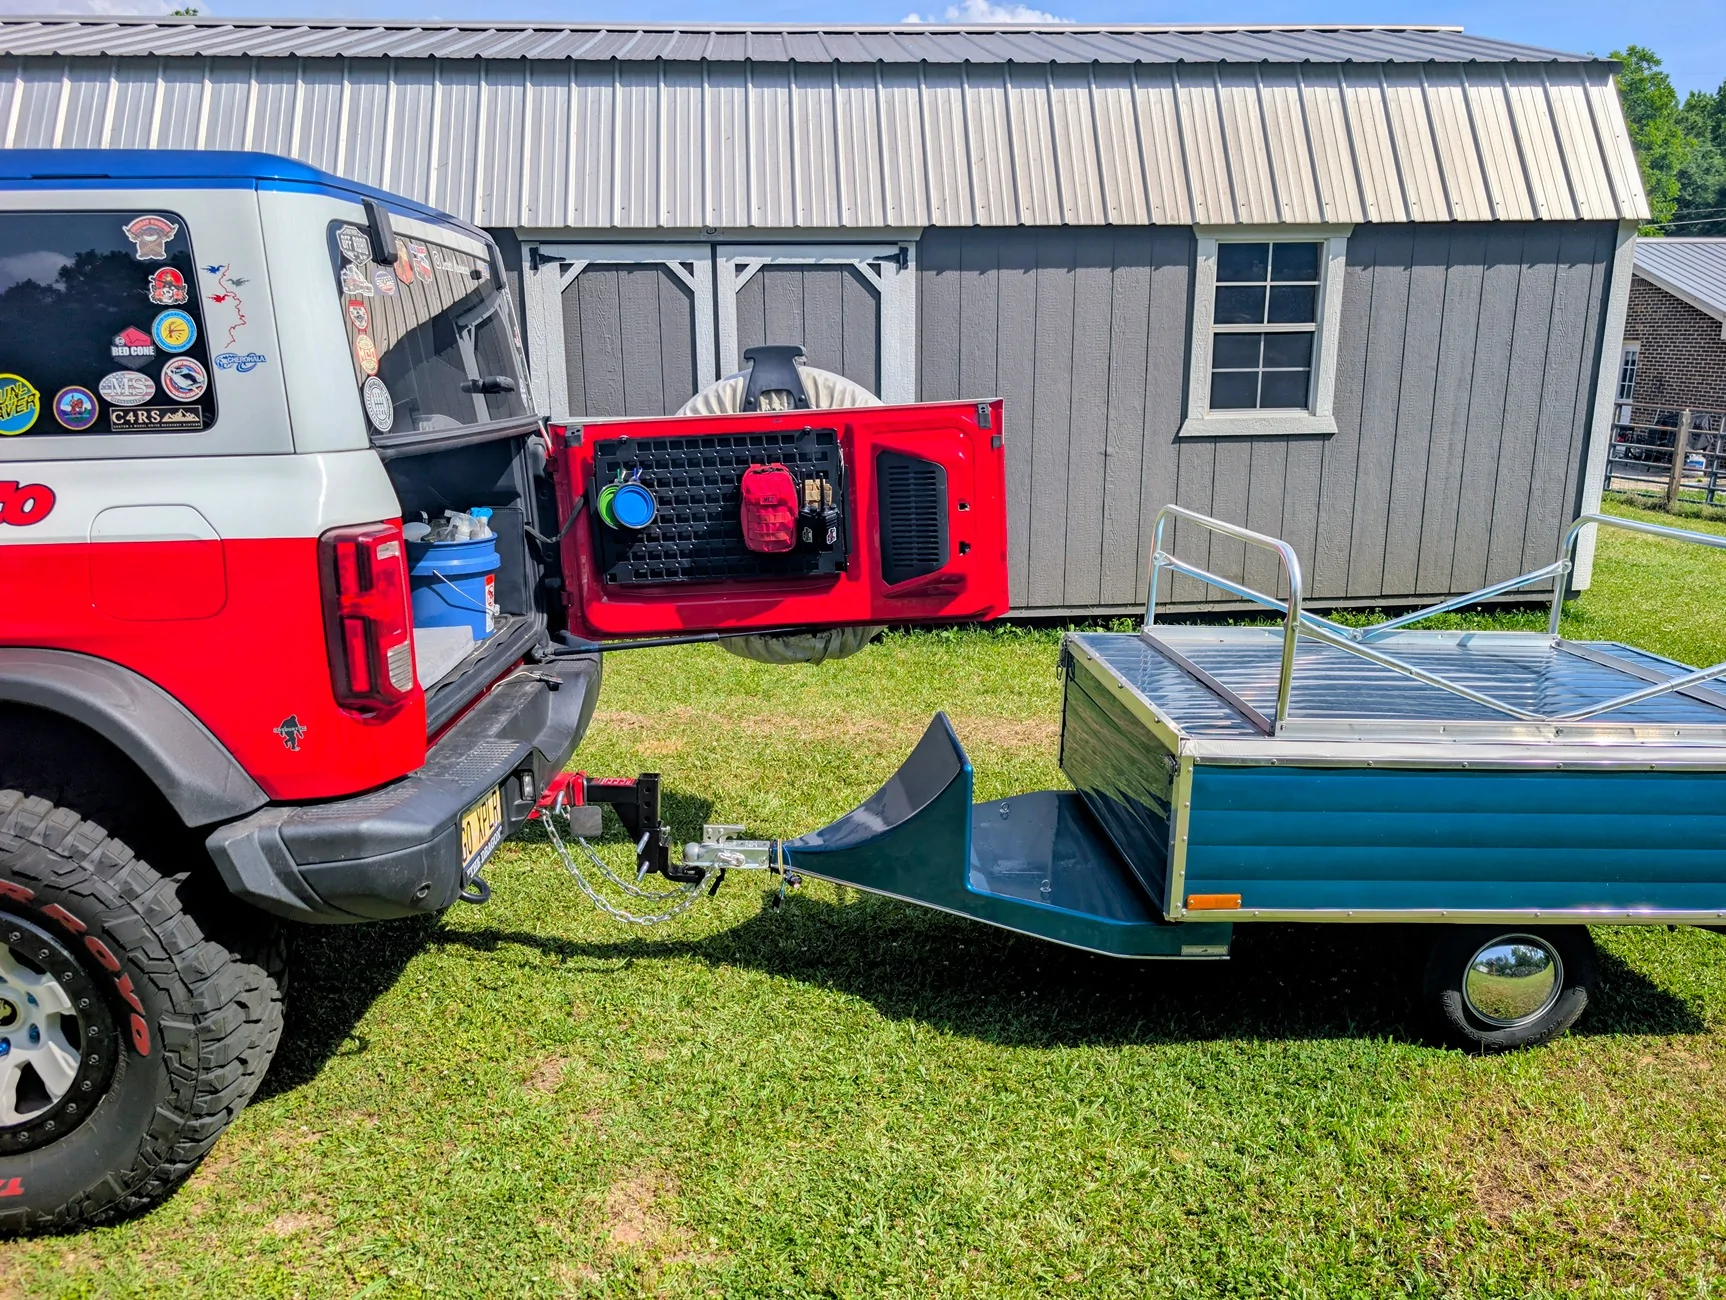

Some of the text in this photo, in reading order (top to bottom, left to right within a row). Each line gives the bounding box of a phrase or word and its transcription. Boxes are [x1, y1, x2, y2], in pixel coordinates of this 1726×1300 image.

[111, 346, 154, 356] RED CONE
[110, 378, 147, 396] MS
[112, 410, 160, 424] C4RS
[476, 790, 499, 844] XPLR
